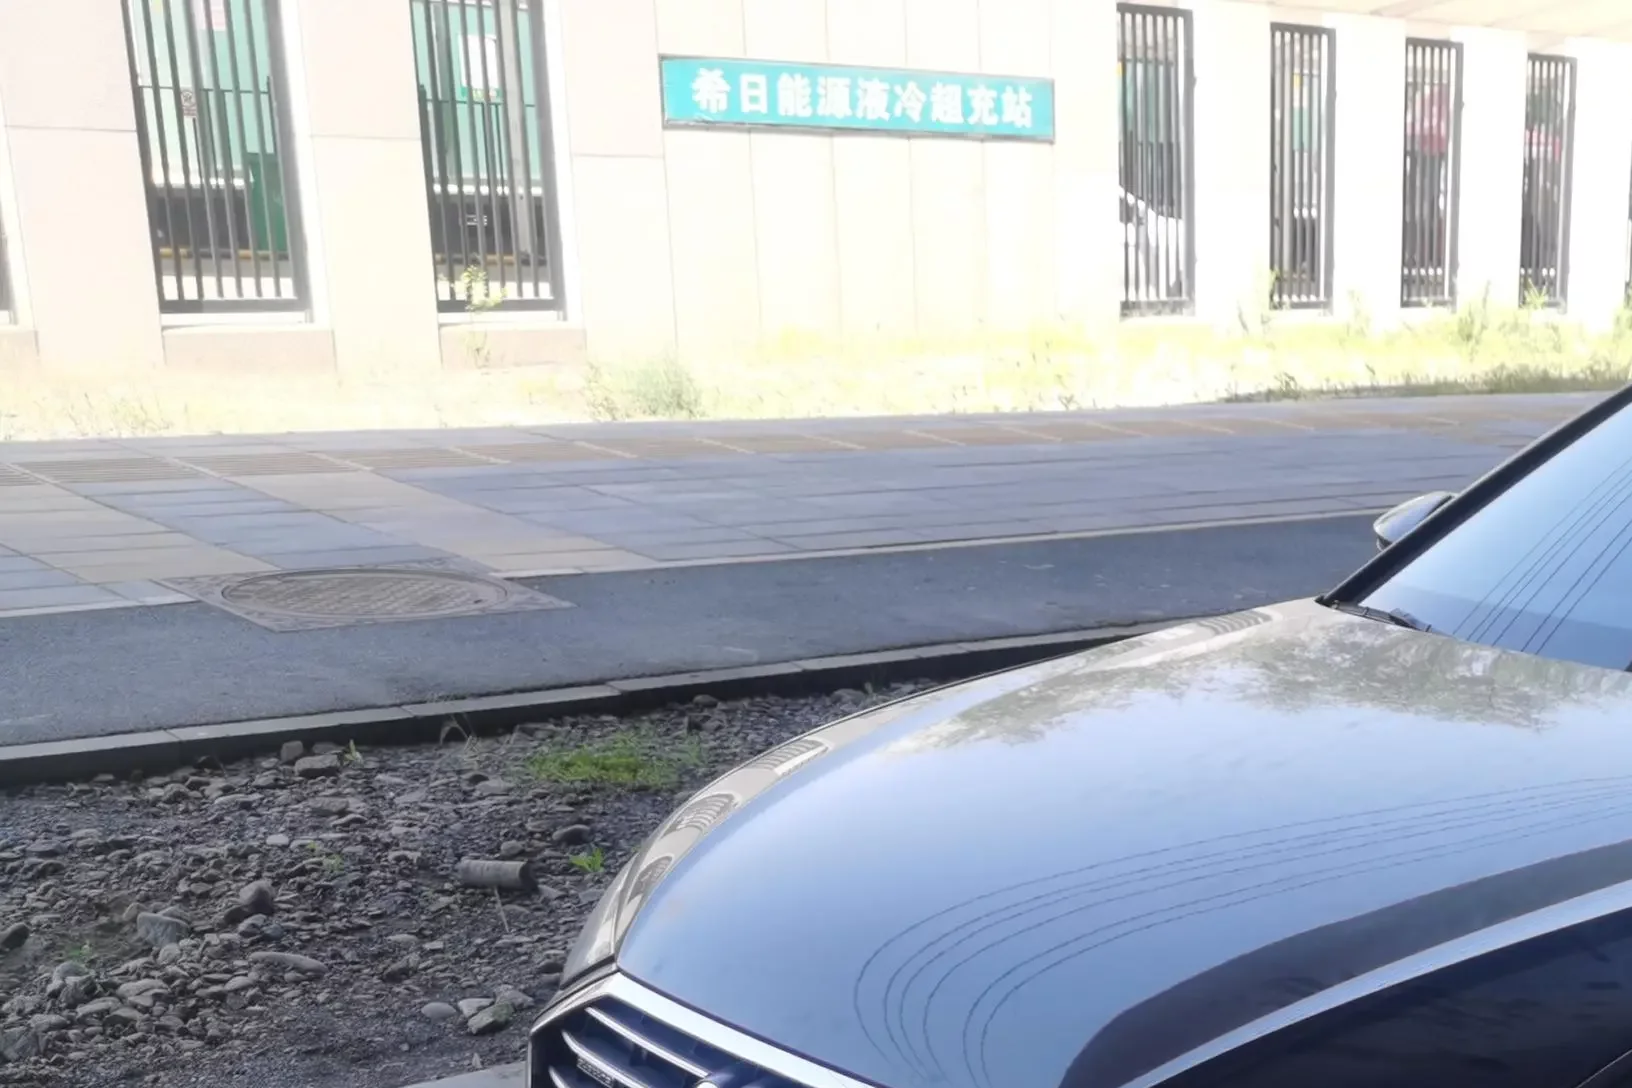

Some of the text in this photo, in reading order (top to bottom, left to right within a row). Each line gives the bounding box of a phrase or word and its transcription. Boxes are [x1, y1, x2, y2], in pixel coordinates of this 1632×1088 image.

[692, 67, 1033, 128] 希日能源液冷超充站
